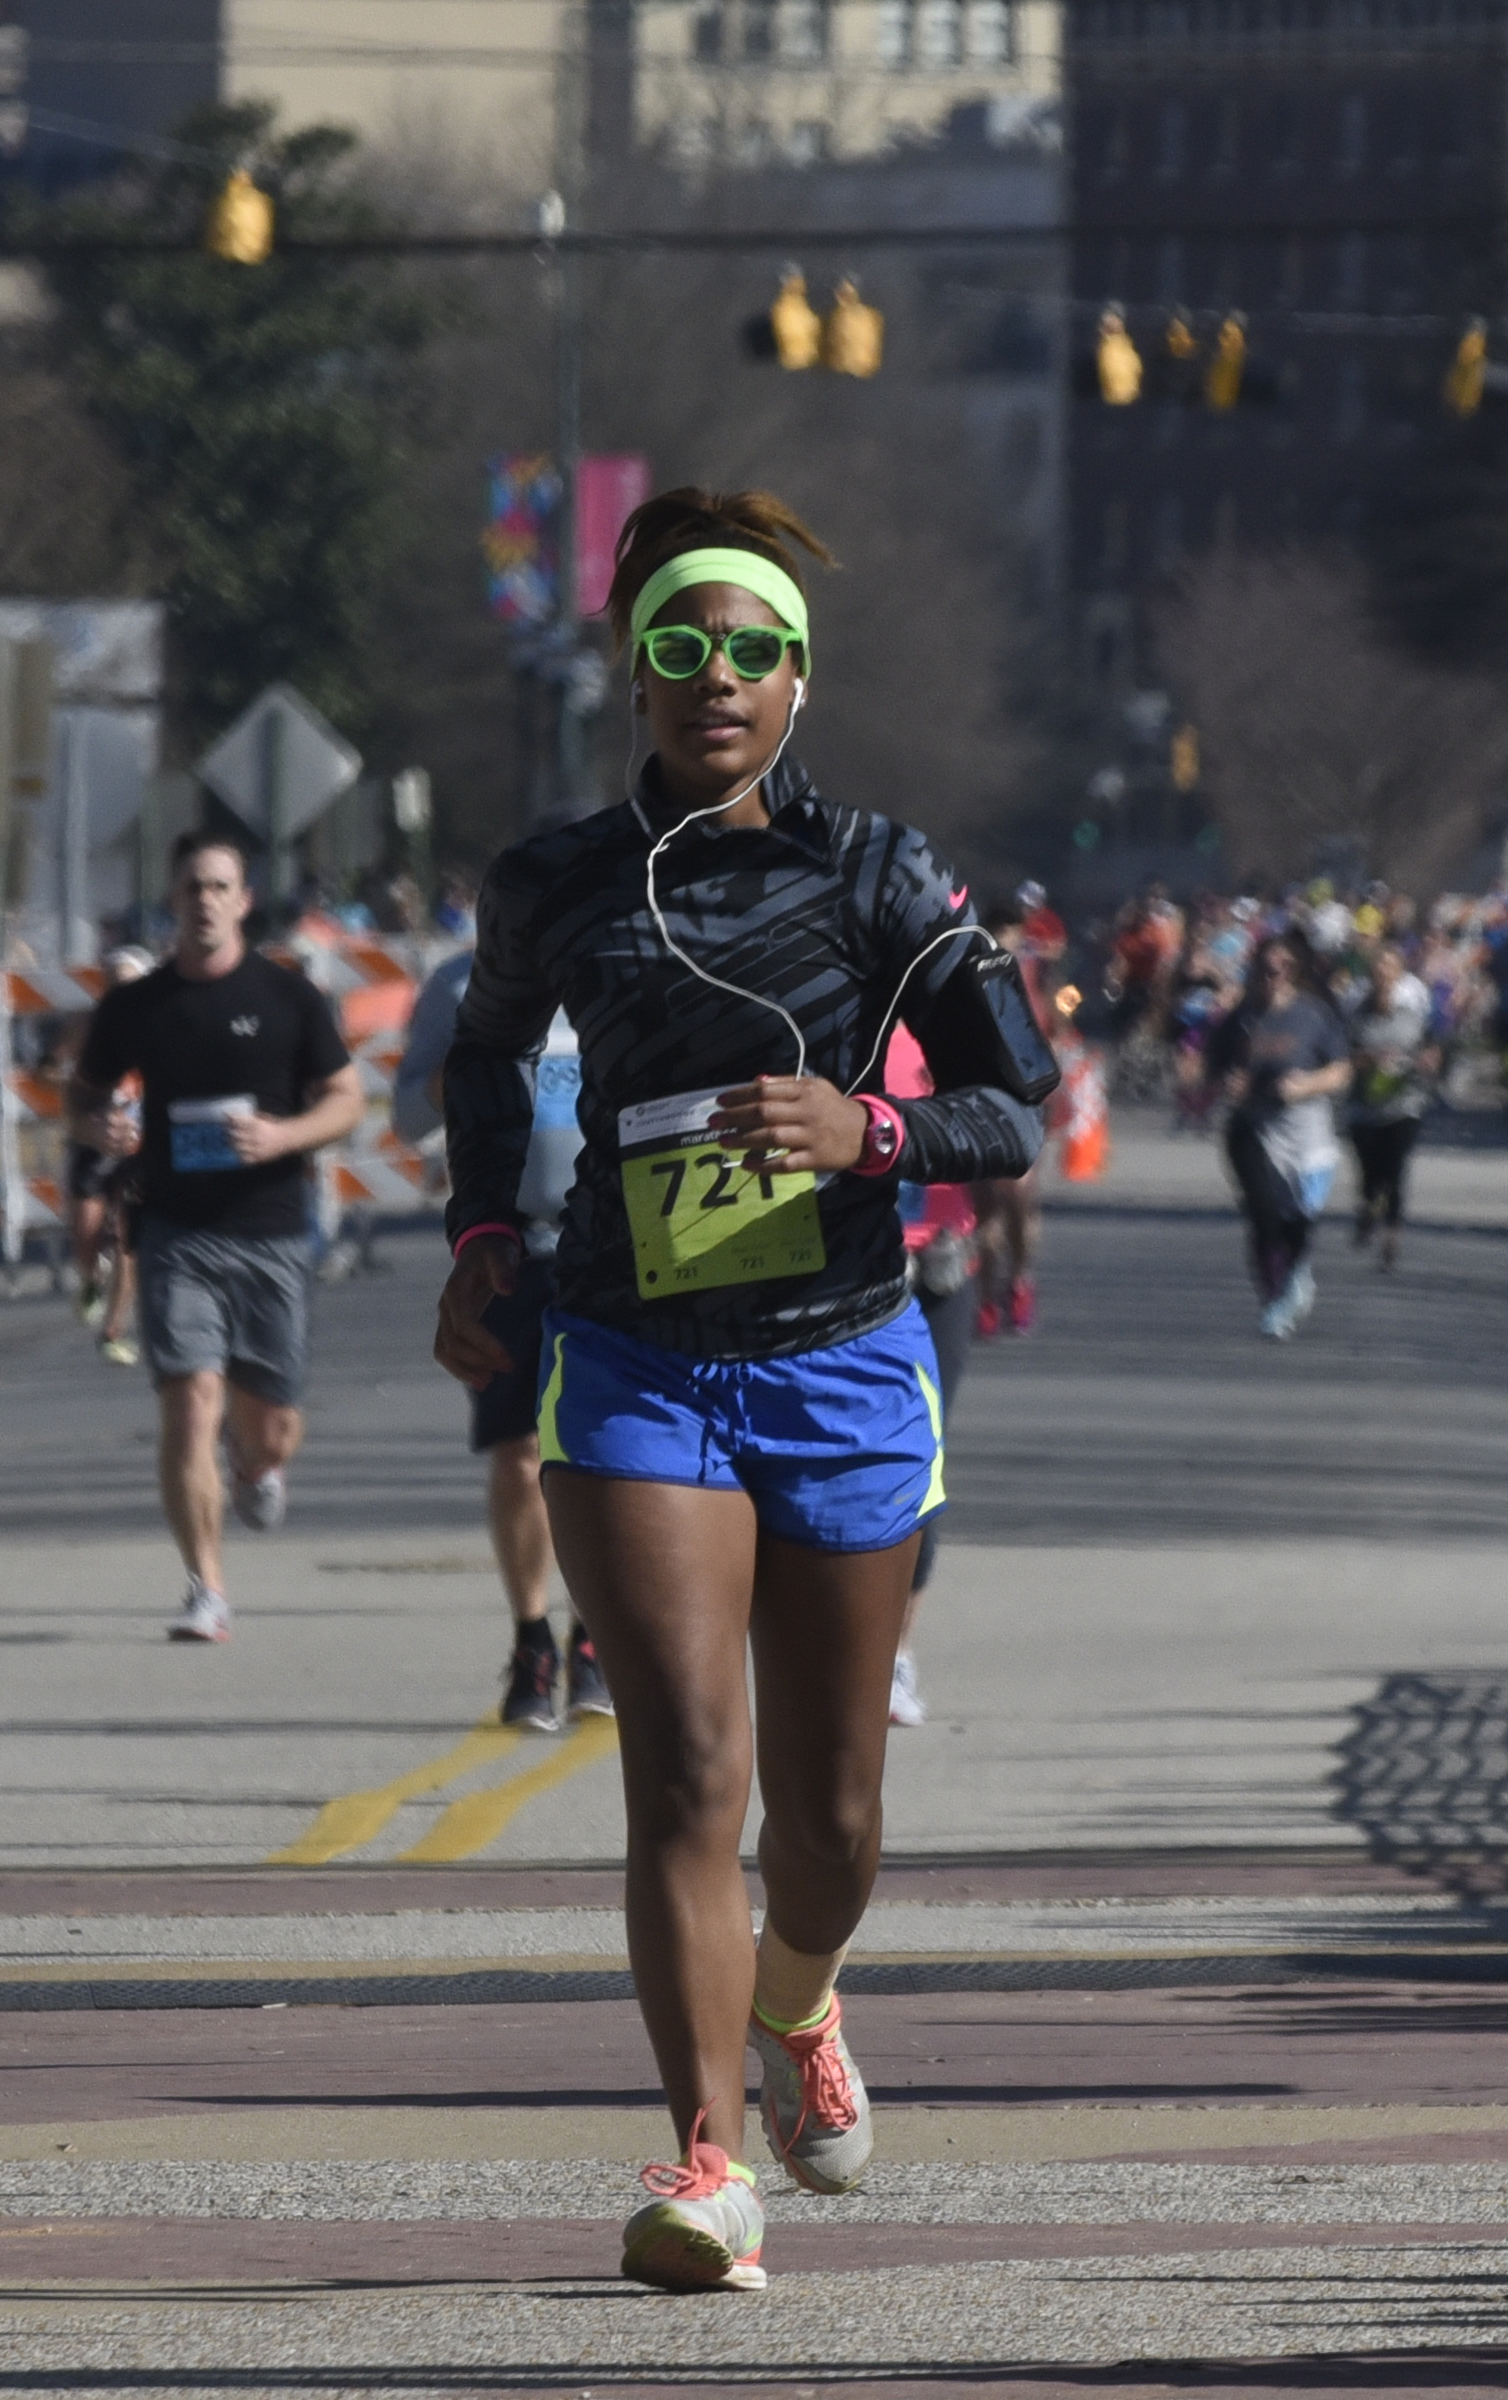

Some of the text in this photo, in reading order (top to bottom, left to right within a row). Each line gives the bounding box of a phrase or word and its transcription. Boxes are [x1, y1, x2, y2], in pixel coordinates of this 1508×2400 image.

[650, 1148, 775, 1218] 721
[674, 1266, 698, 1280] 721
[740, 1256, 764, 1270] 721
